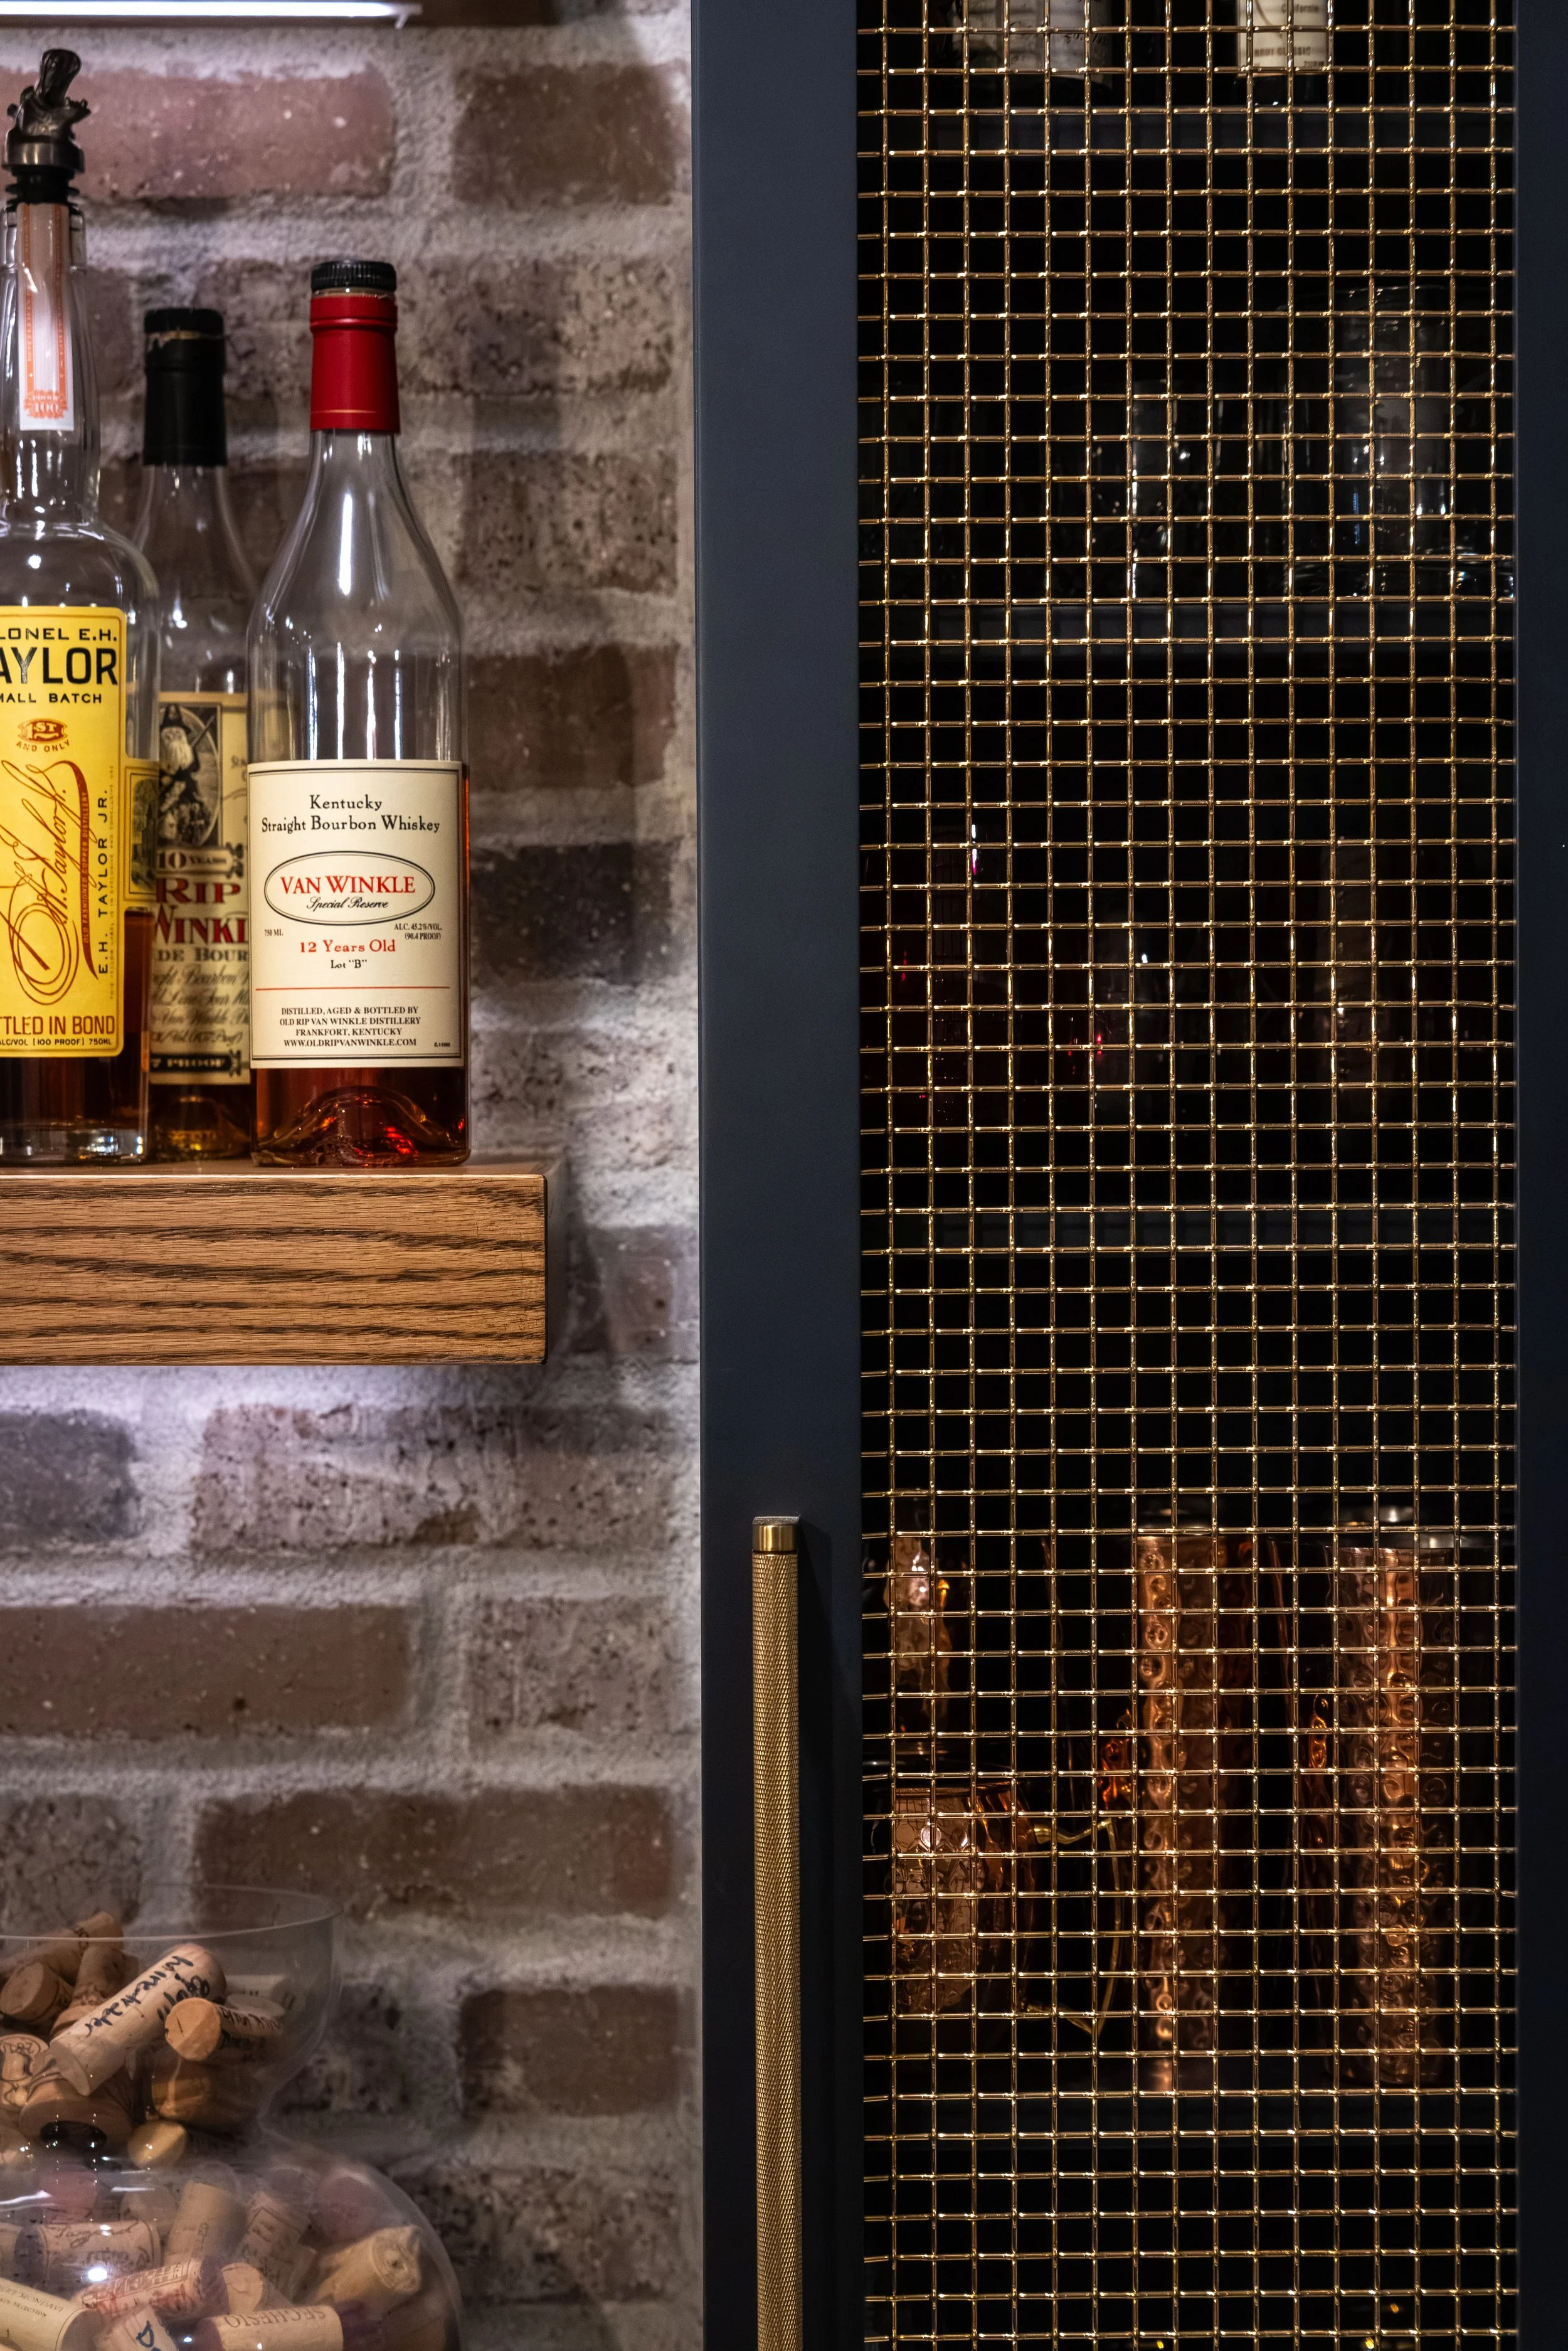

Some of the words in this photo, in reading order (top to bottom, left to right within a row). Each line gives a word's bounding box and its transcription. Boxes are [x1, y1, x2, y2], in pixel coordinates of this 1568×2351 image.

[79, 628, 117, 641] E.H.
[48, 693, 102, 704] BATCH
[16, 741, 37, 751] AND
[44, 739, 70, 753] ONLY
[97, 788, 109, 823] JR.
[309, 794, 383, 811] Kentucky
[262, 816, 306, 834] Straight
[310, 815, 376, 831] Bourbon
[381, 814, 440, 833] Whiskey
[158, 851, 186, 869] 10
[97, 837, 109, 918] TAYLOR
[280, 876, 322, 894] VAN
[325, 875, 416, 894] WINKLE
[156, 877, 241, 903] RIP
[306, 896, 347, 913] Special
[347, 896, 389, 909] Reserve
[394, 923, 410, 931] ALC.
[300, 942, 317, 953] 12
[323, 939, 365, 952] Years
[369, 938, 396, 952] Old
[98, 933, 109, 975] E.H.
[330, 959, 346, 969] Lot
[282, 1007, 325, 1016] DISTILLED,
[326, 1007, 352, 1015] AGED
[363, 1006, 406, 1014] BOTTLED
[407, 1006, 419, 1014] BY
[0, 1016, 43, 1035] TLED
[49, 1016, 66, 1035] IN
[72, 1016, 115, 1035] BOND
[369, 1017, 421, 1025] DISTILLERY
[352, 1027, 403, 1036] KENTUCKY
[283, 1038, 417, 1048] WWW.OLDRIPVANWINKLE.COM
